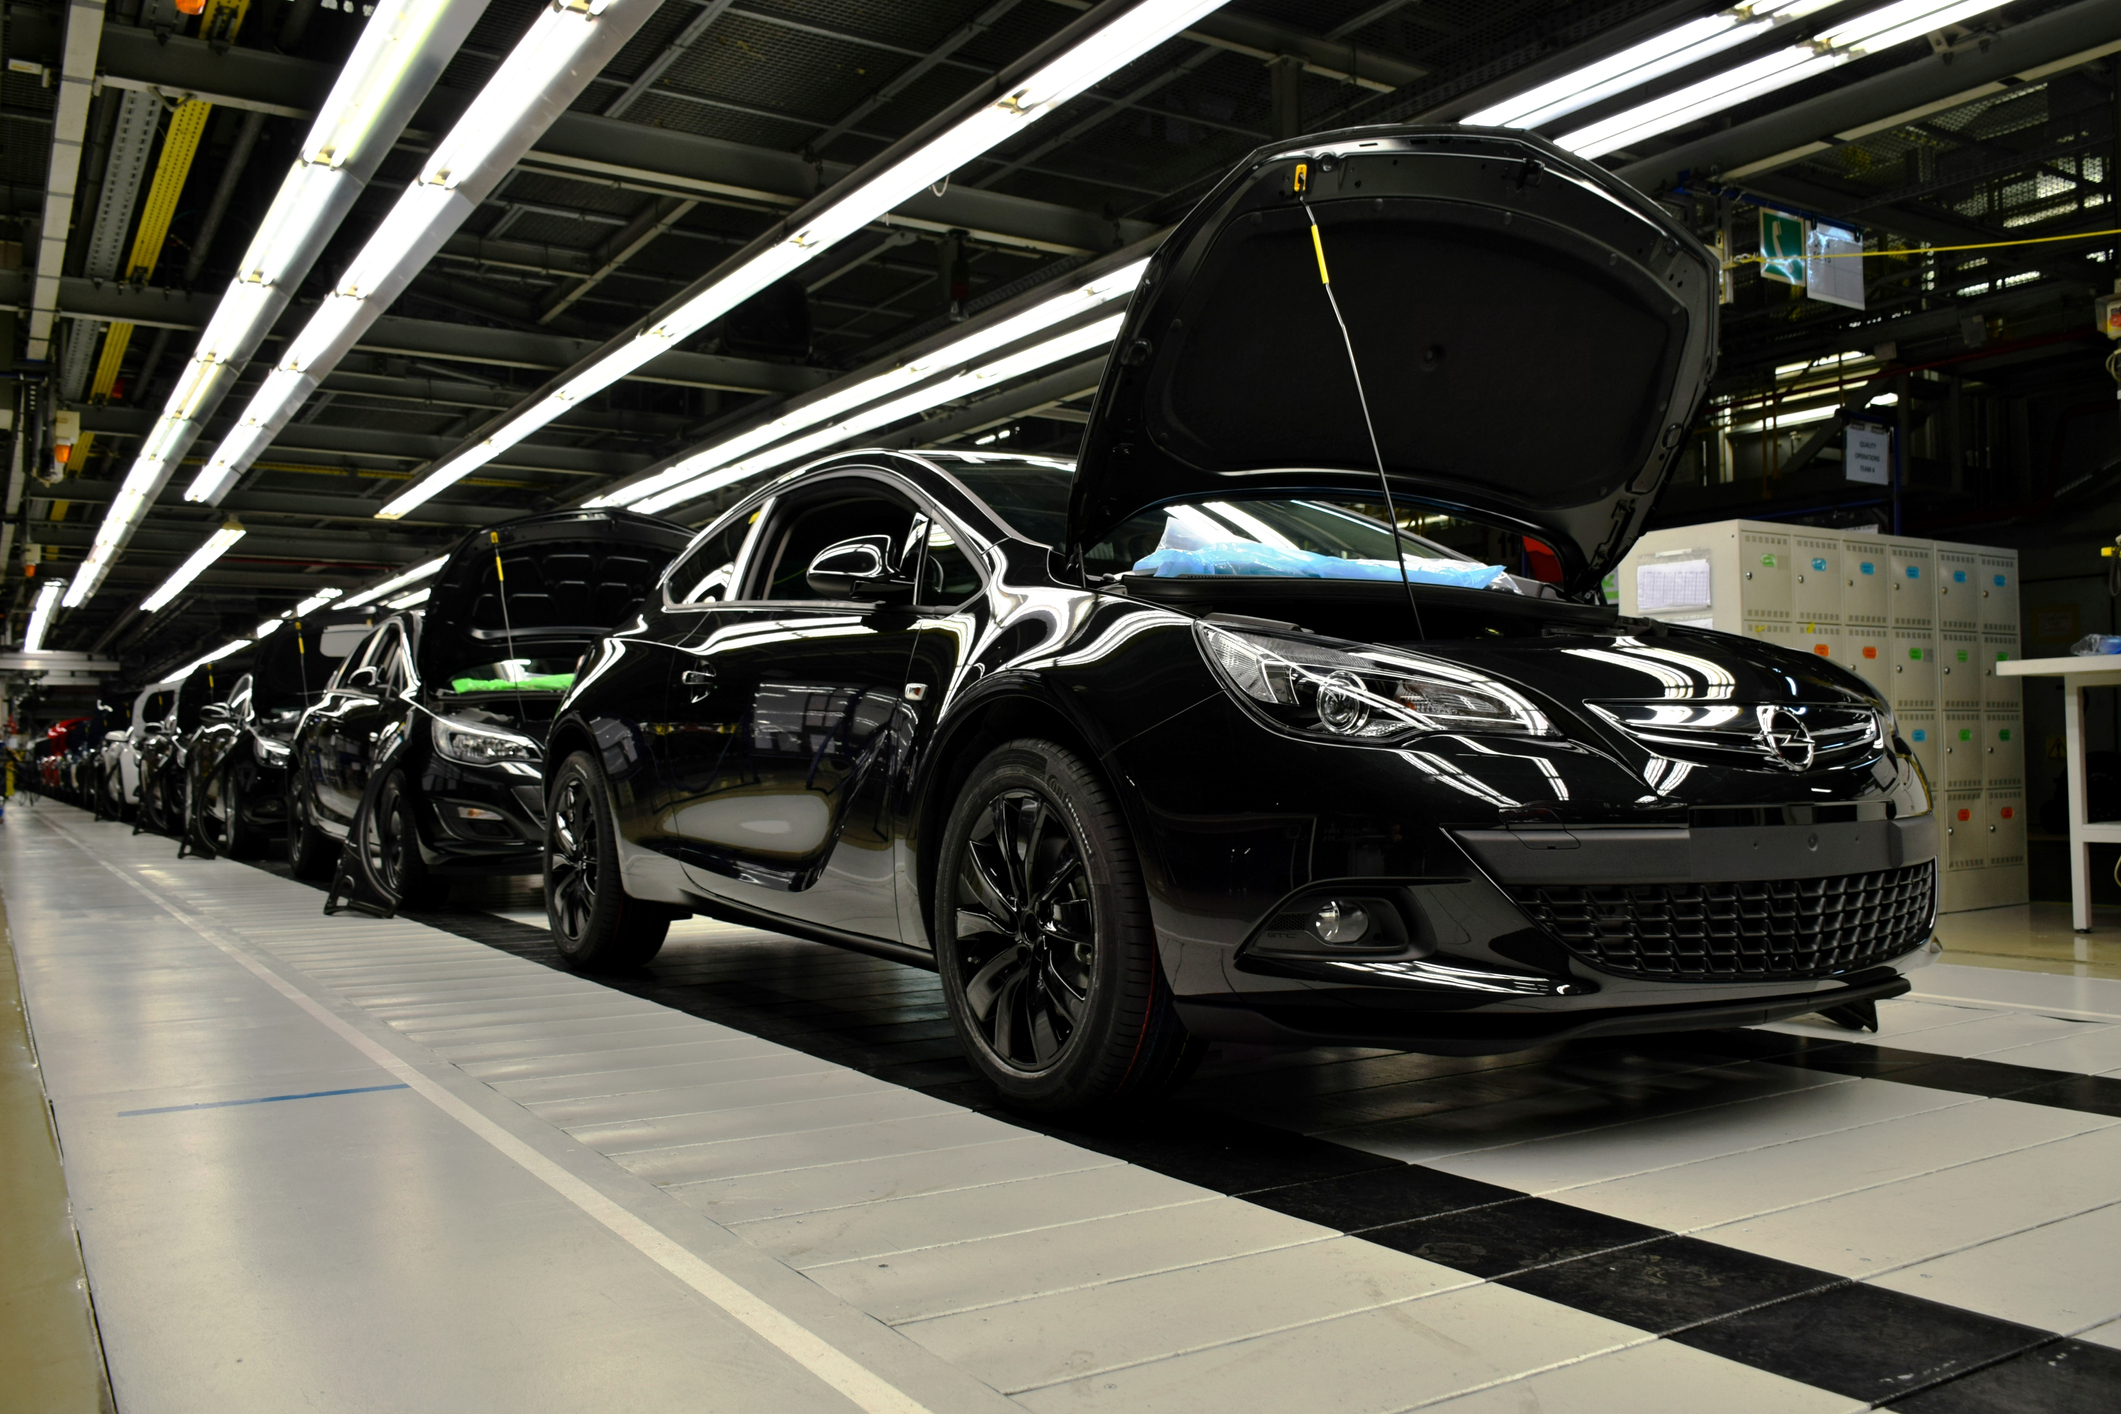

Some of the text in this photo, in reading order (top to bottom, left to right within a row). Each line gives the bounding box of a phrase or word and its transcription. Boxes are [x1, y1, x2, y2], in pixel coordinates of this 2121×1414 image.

[1859, 441, 1877, 449] QUALITY
[1854, 452, 1881, 462] OPERATIONS
[1498, 532, 1516, 557] 11
